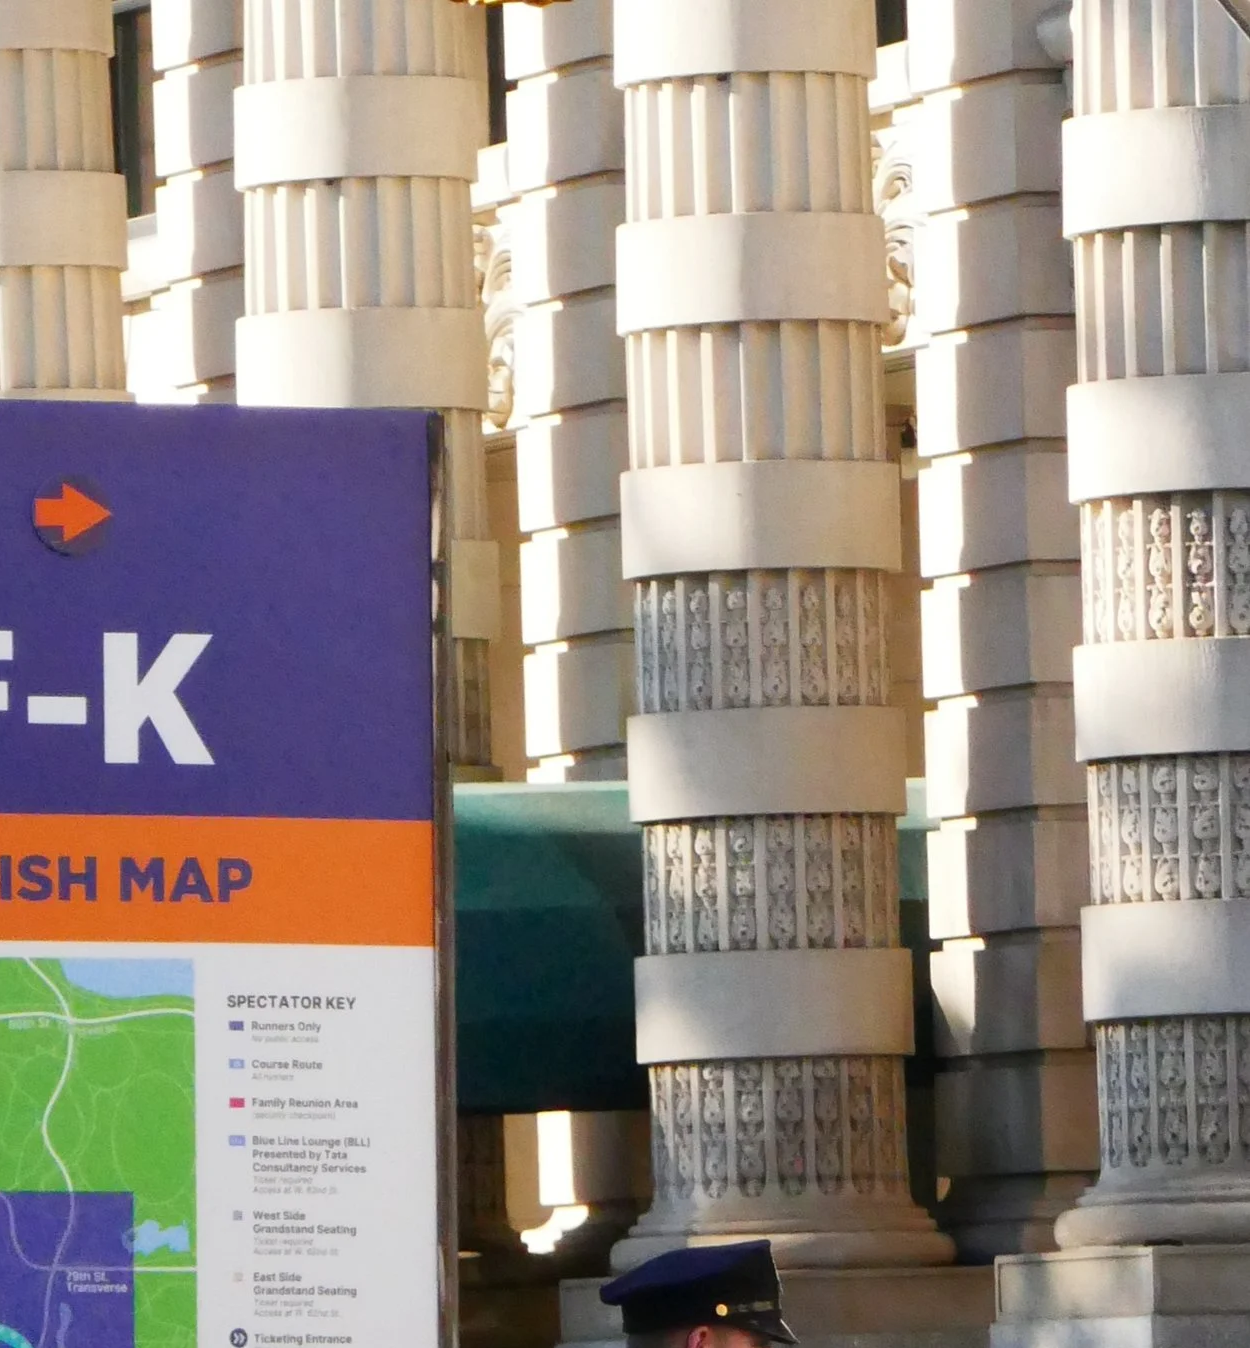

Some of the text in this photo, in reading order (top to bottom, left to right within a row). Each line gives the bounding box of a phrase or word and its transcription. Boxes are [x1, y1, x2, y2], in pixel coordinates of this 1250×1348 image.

[120, 857, 253, 902] MAP
[227, 995, 356, 1010] SPECTATOR KEY
[251, 1021, 321, 1032] Runners Only
[252, 1060, 323, 1070] Course Route
[252, 1098, 358, 1109] Family Reunion Area
[252, 1136, 370, 1148] Blue Line Lounge (BLL)
[253, 1149, 348, 1161] Presented by Tata
[253, 1163, 366, 1175] Consultancy Services
[253, 1211, 305, 1220] West Side
[253, 1224, 357, 1236] Grandstand Seating
[254, 1273, 302, 1282] East Side
[254, 1287, 357, 1297] Grandstand Seating
[255, 1334, 352, 1345] Ticketing Entrance
